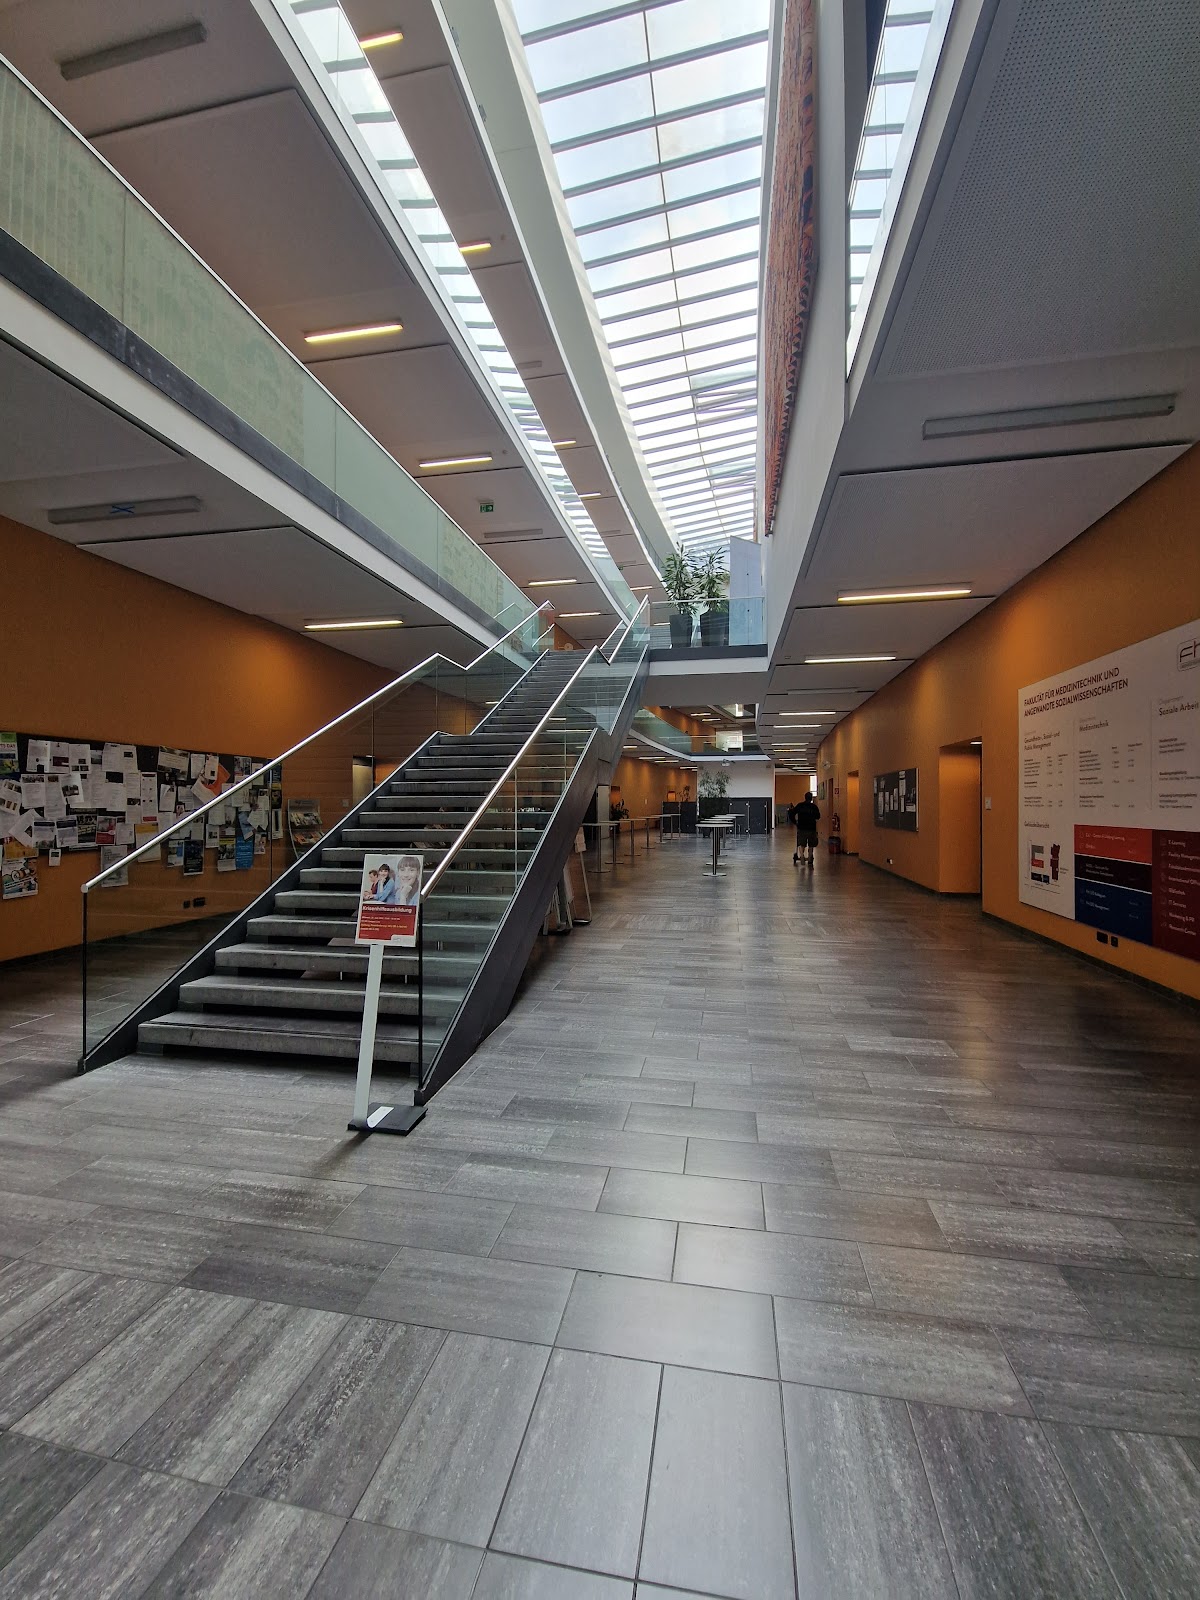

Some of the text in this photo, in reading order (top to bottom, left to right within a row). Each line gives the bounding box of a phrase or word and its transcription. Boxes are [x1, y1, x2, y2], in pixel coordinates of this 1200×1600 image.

[1024, 667, 1120, 706] FAKULTÄT FÜR MEDIZINTECHNIK UND
[1024, 678, 1129, 717] ANGEWANDTE SOZIALWISSENSCHAFTEN
[1158, 705, 1178, 716] Soziale
[1179, 700, 1199, 711] Arbeit
